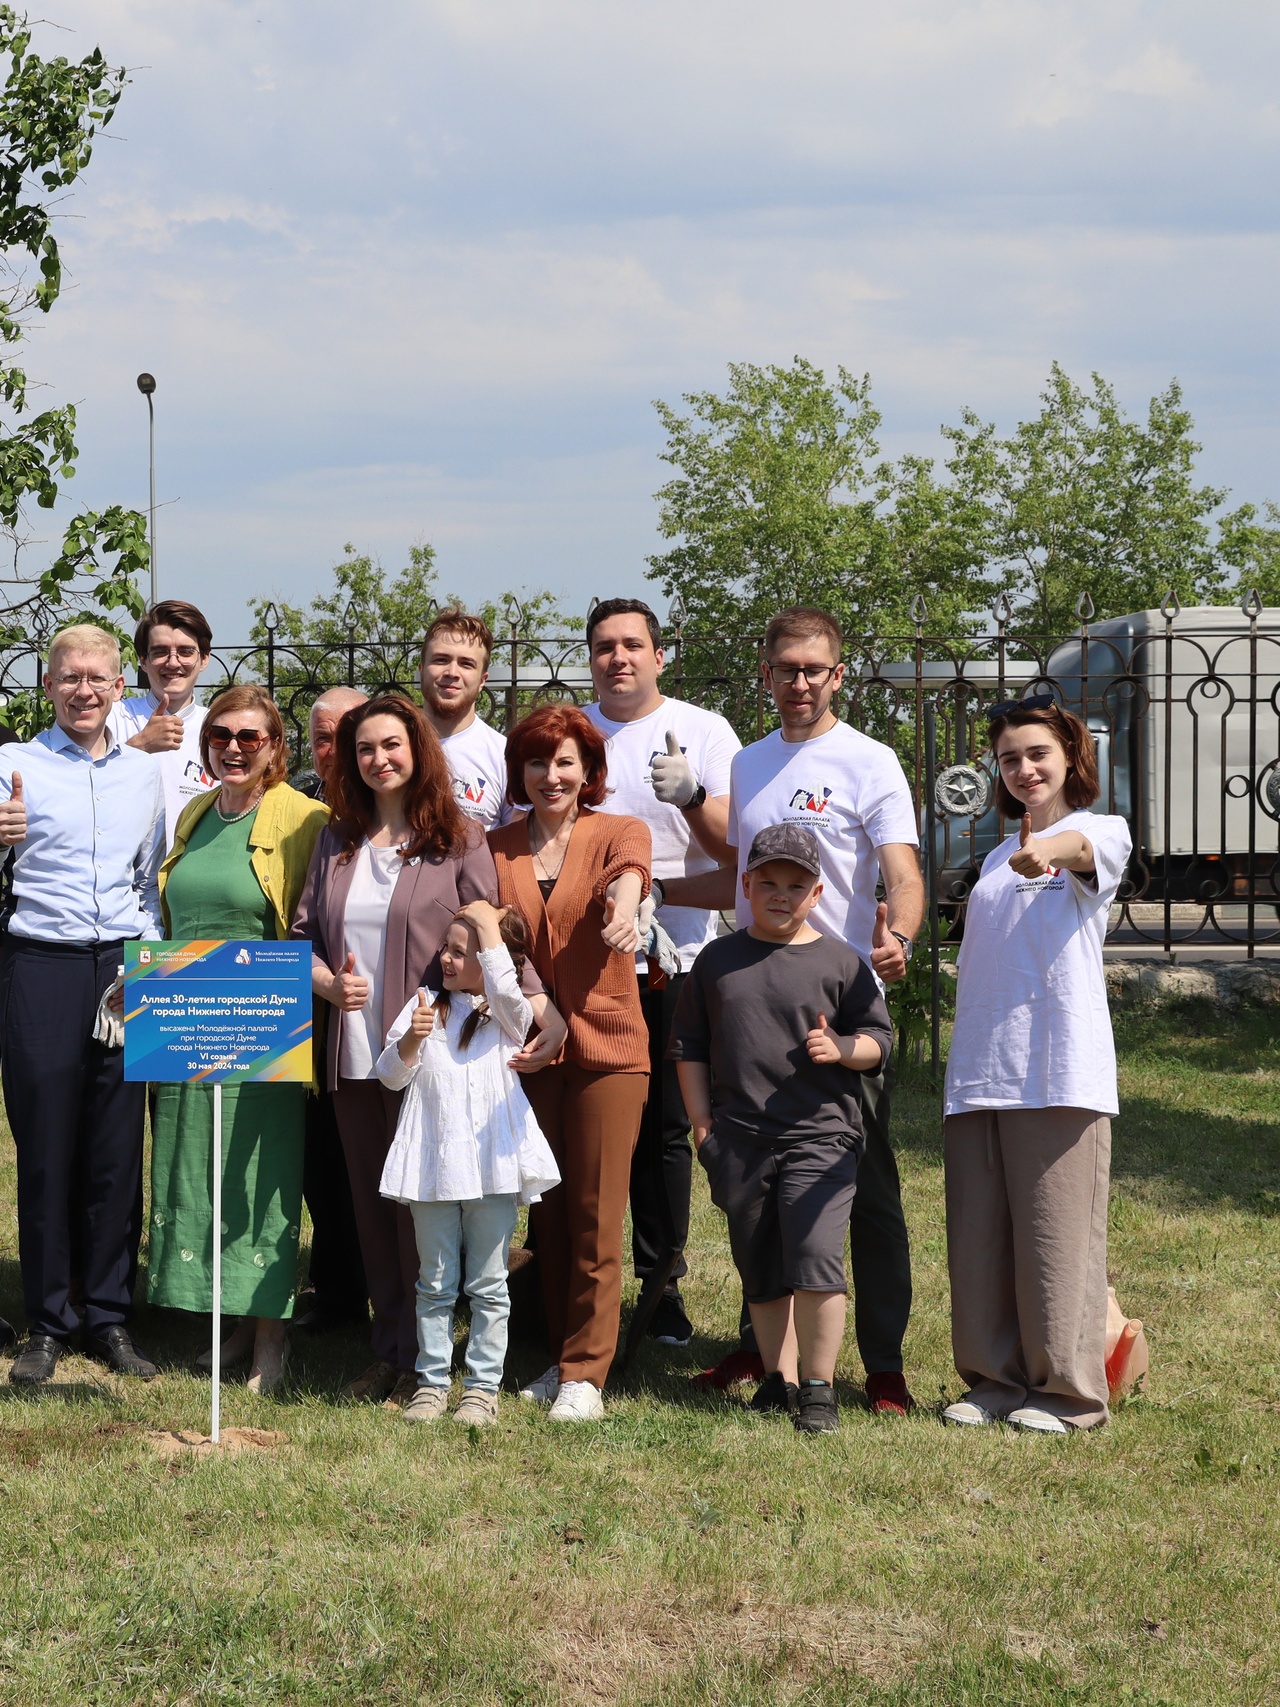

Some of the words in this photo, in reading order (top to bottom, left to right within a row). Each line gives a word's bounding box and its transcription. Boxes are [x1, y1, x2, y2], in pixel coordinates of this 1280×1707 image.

[140, 994, 170, 1004] Аллея
[172, 994, 216, 1004] 30-летия
[217, 994, 268, 1006] городской
[269, 994, 297, 1006] Думы
[152, 1008, 185, 1017] города
[188, 1006, 231, 1016] Нижнего
[233, 1006, 285, 1017] Новгорода
[197, 1024, 246, 1033] Молодёжной
[248, 1024, 277, 1032] палатой
[196, 1034, 235, 1043] городской
[236, 1034, 257, 1043] Думе
[194, 1043, 228, 1051] Нижнего
[229, 1043, 270, 1051] Новгорода
[187, 1062, 197, 1070] 30
[213, 1062, 232, 1070] 2024
[233, 1063, 250, 1071] года
